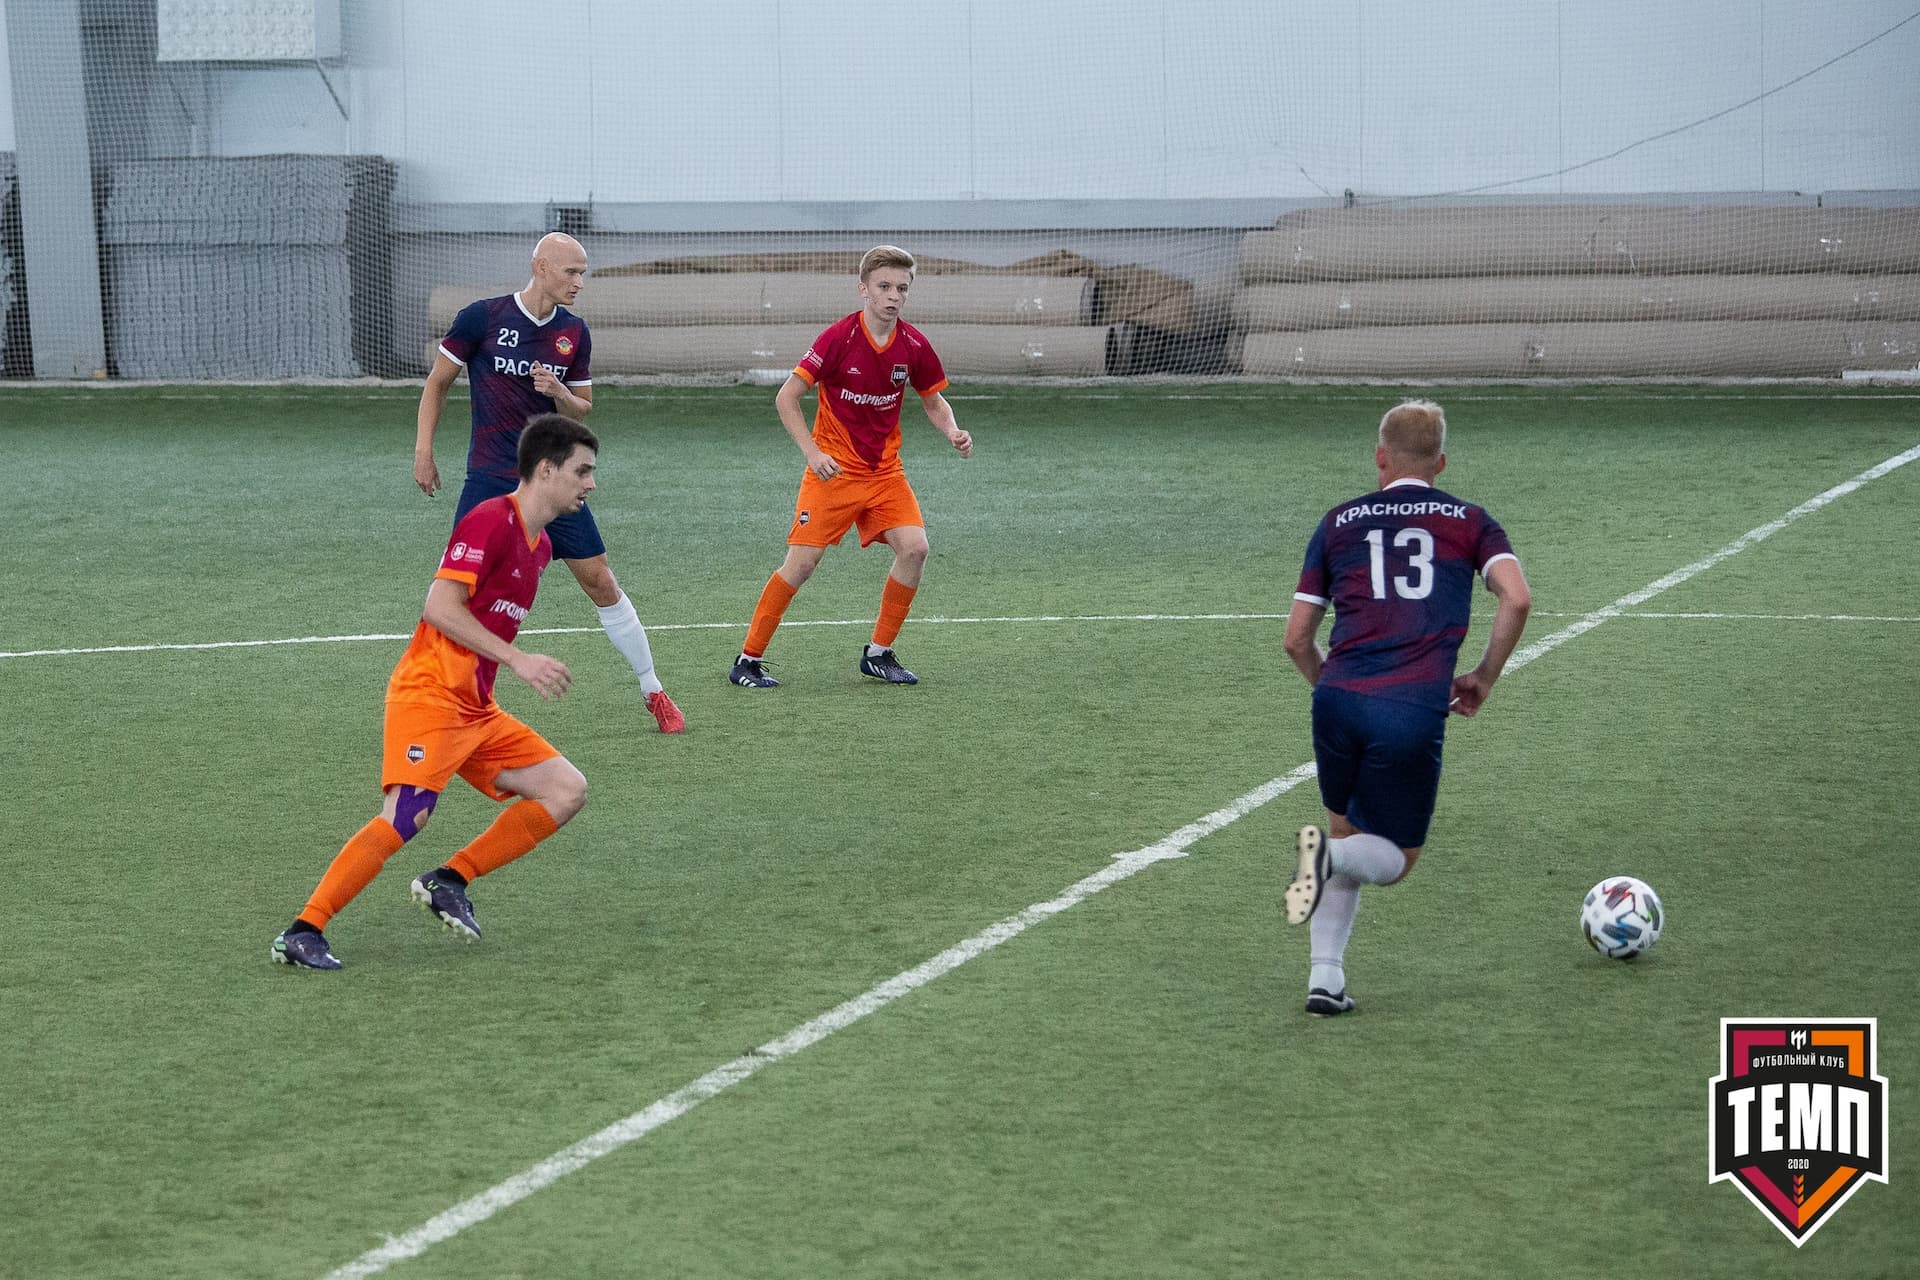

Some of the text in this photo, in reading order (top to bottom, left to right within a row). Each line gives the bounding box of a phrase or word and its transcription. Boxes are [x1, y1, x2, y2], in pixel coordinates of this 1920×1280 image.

[497, 328, 519, 348] 23
[1335, 502, 1466, 527] КРАСНОЯРСК
[1363, 528, 1435, 600] 13
